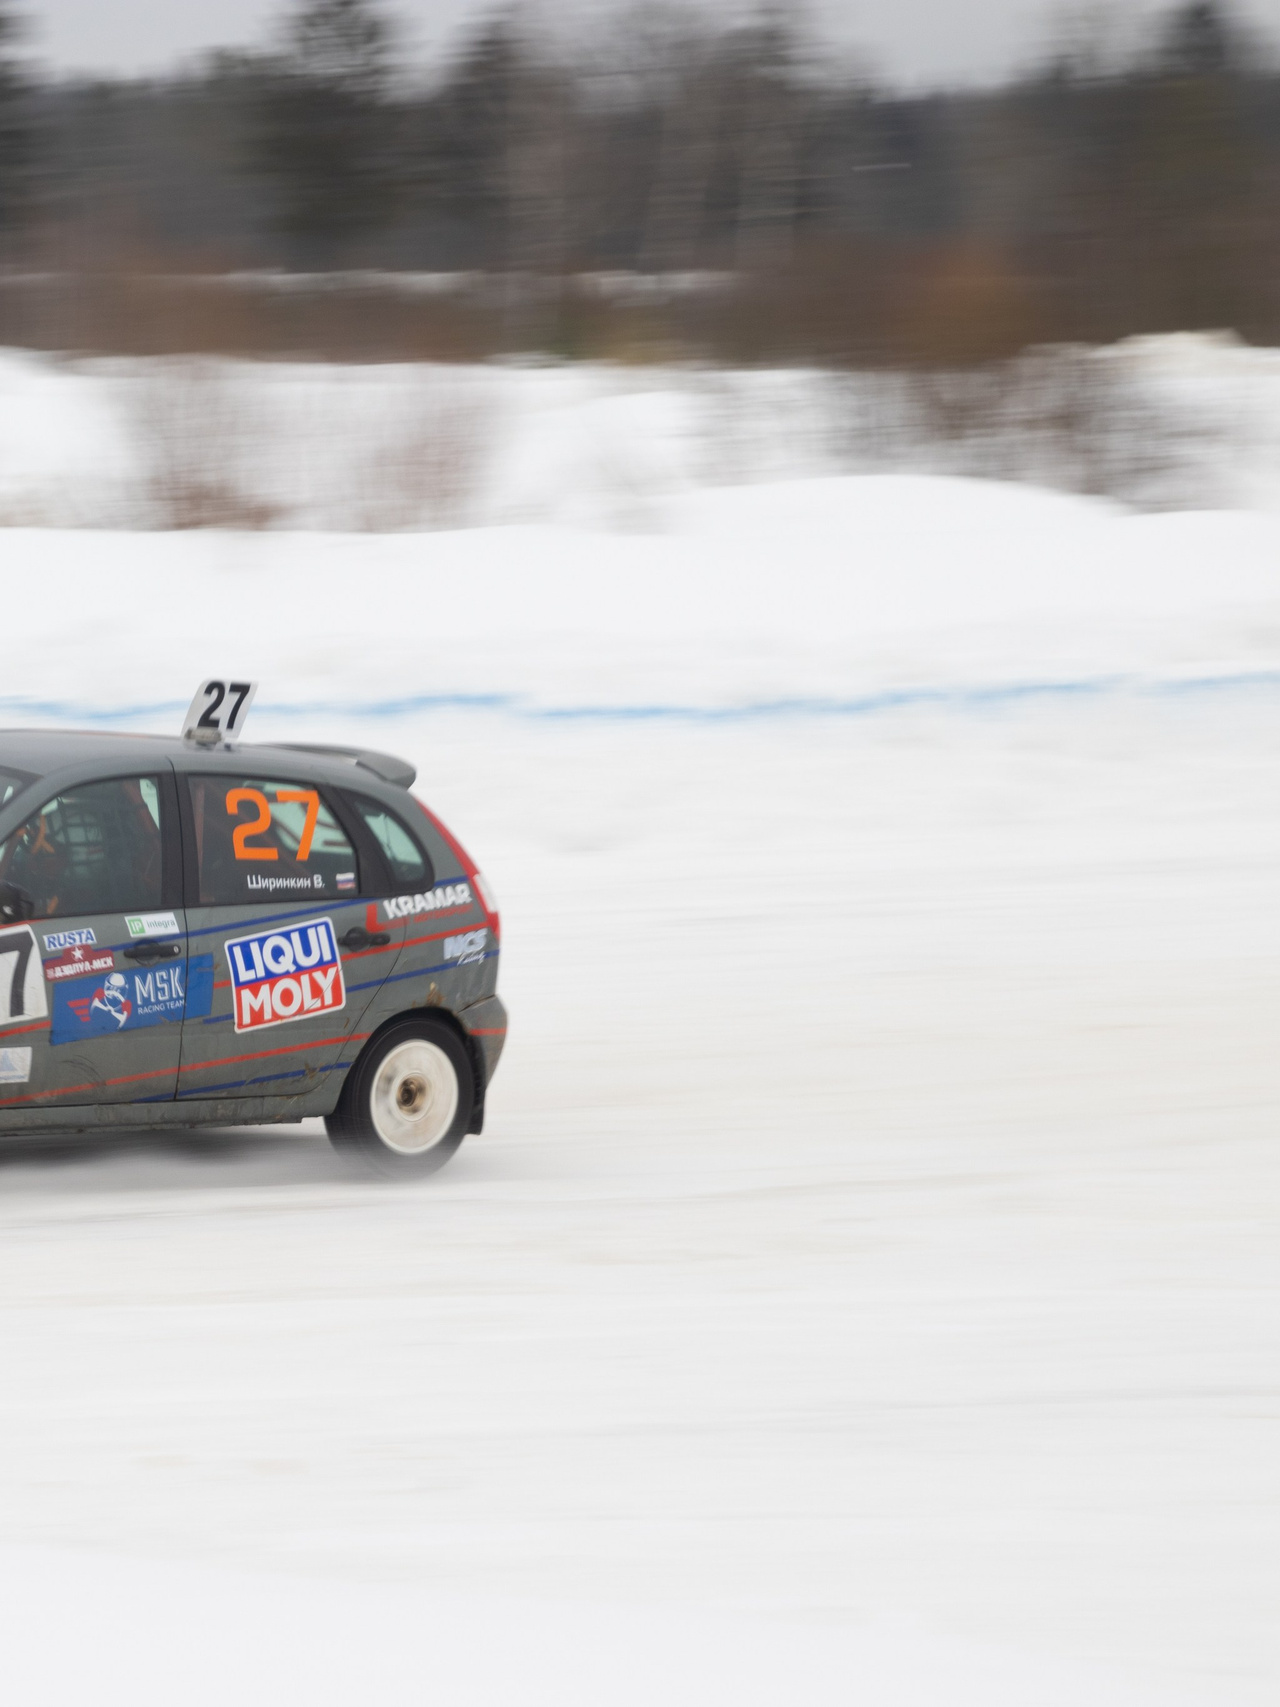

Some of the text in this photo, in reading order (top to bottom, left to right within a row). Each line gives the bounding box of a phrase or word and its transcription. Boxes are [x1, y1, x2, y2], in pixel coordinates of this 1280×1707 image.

[197, 680, 251, 731] 27
[226, 788, 320, 861] 27
[247, 874, 311, 891] Ширинкин
[383, 883, 473, 920] KRAMAR
[47, 929, 95, 949] RUSTA
[233, 925, 333, 983] LIQUI
[134, 966, 185, 1005] MSK
[240, 966, 338, 1025] MOLY
[138, 1002, 165, 1015] RACING
